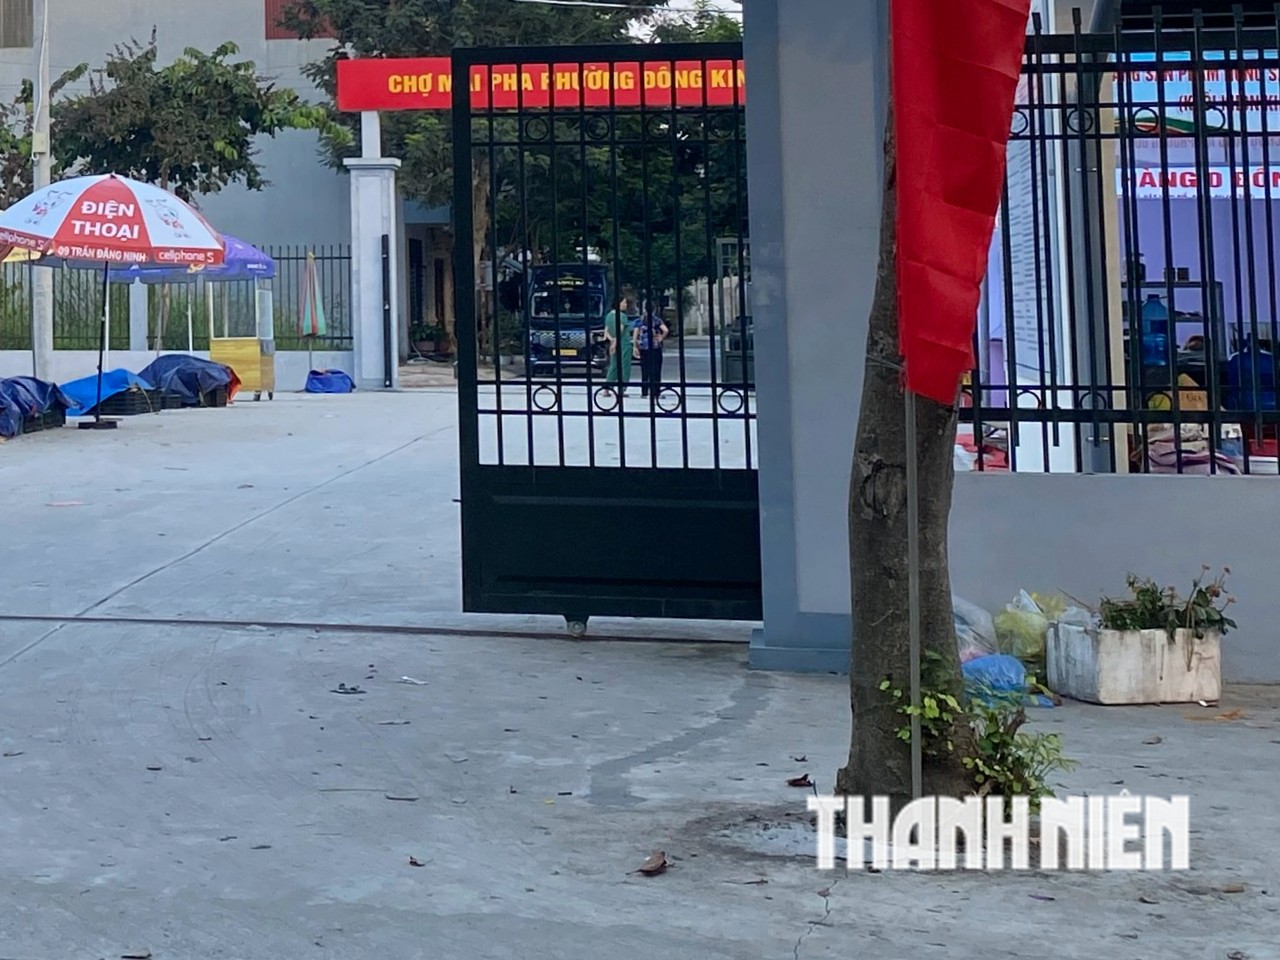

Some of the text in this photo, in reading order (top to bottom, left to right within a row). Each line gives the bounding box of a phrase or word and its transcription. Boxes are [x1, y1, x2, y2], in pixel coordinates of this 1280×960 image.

[388, 72, 433, 97] CHỢ
[438, 73, 481, 93] MI
[492, 72, 534, 92] PHA
[80, 200, 135, 219] ĐIỆN
[71, 219, 139, 241] THOẠI
[159, 250, 205, 262] cellphone
